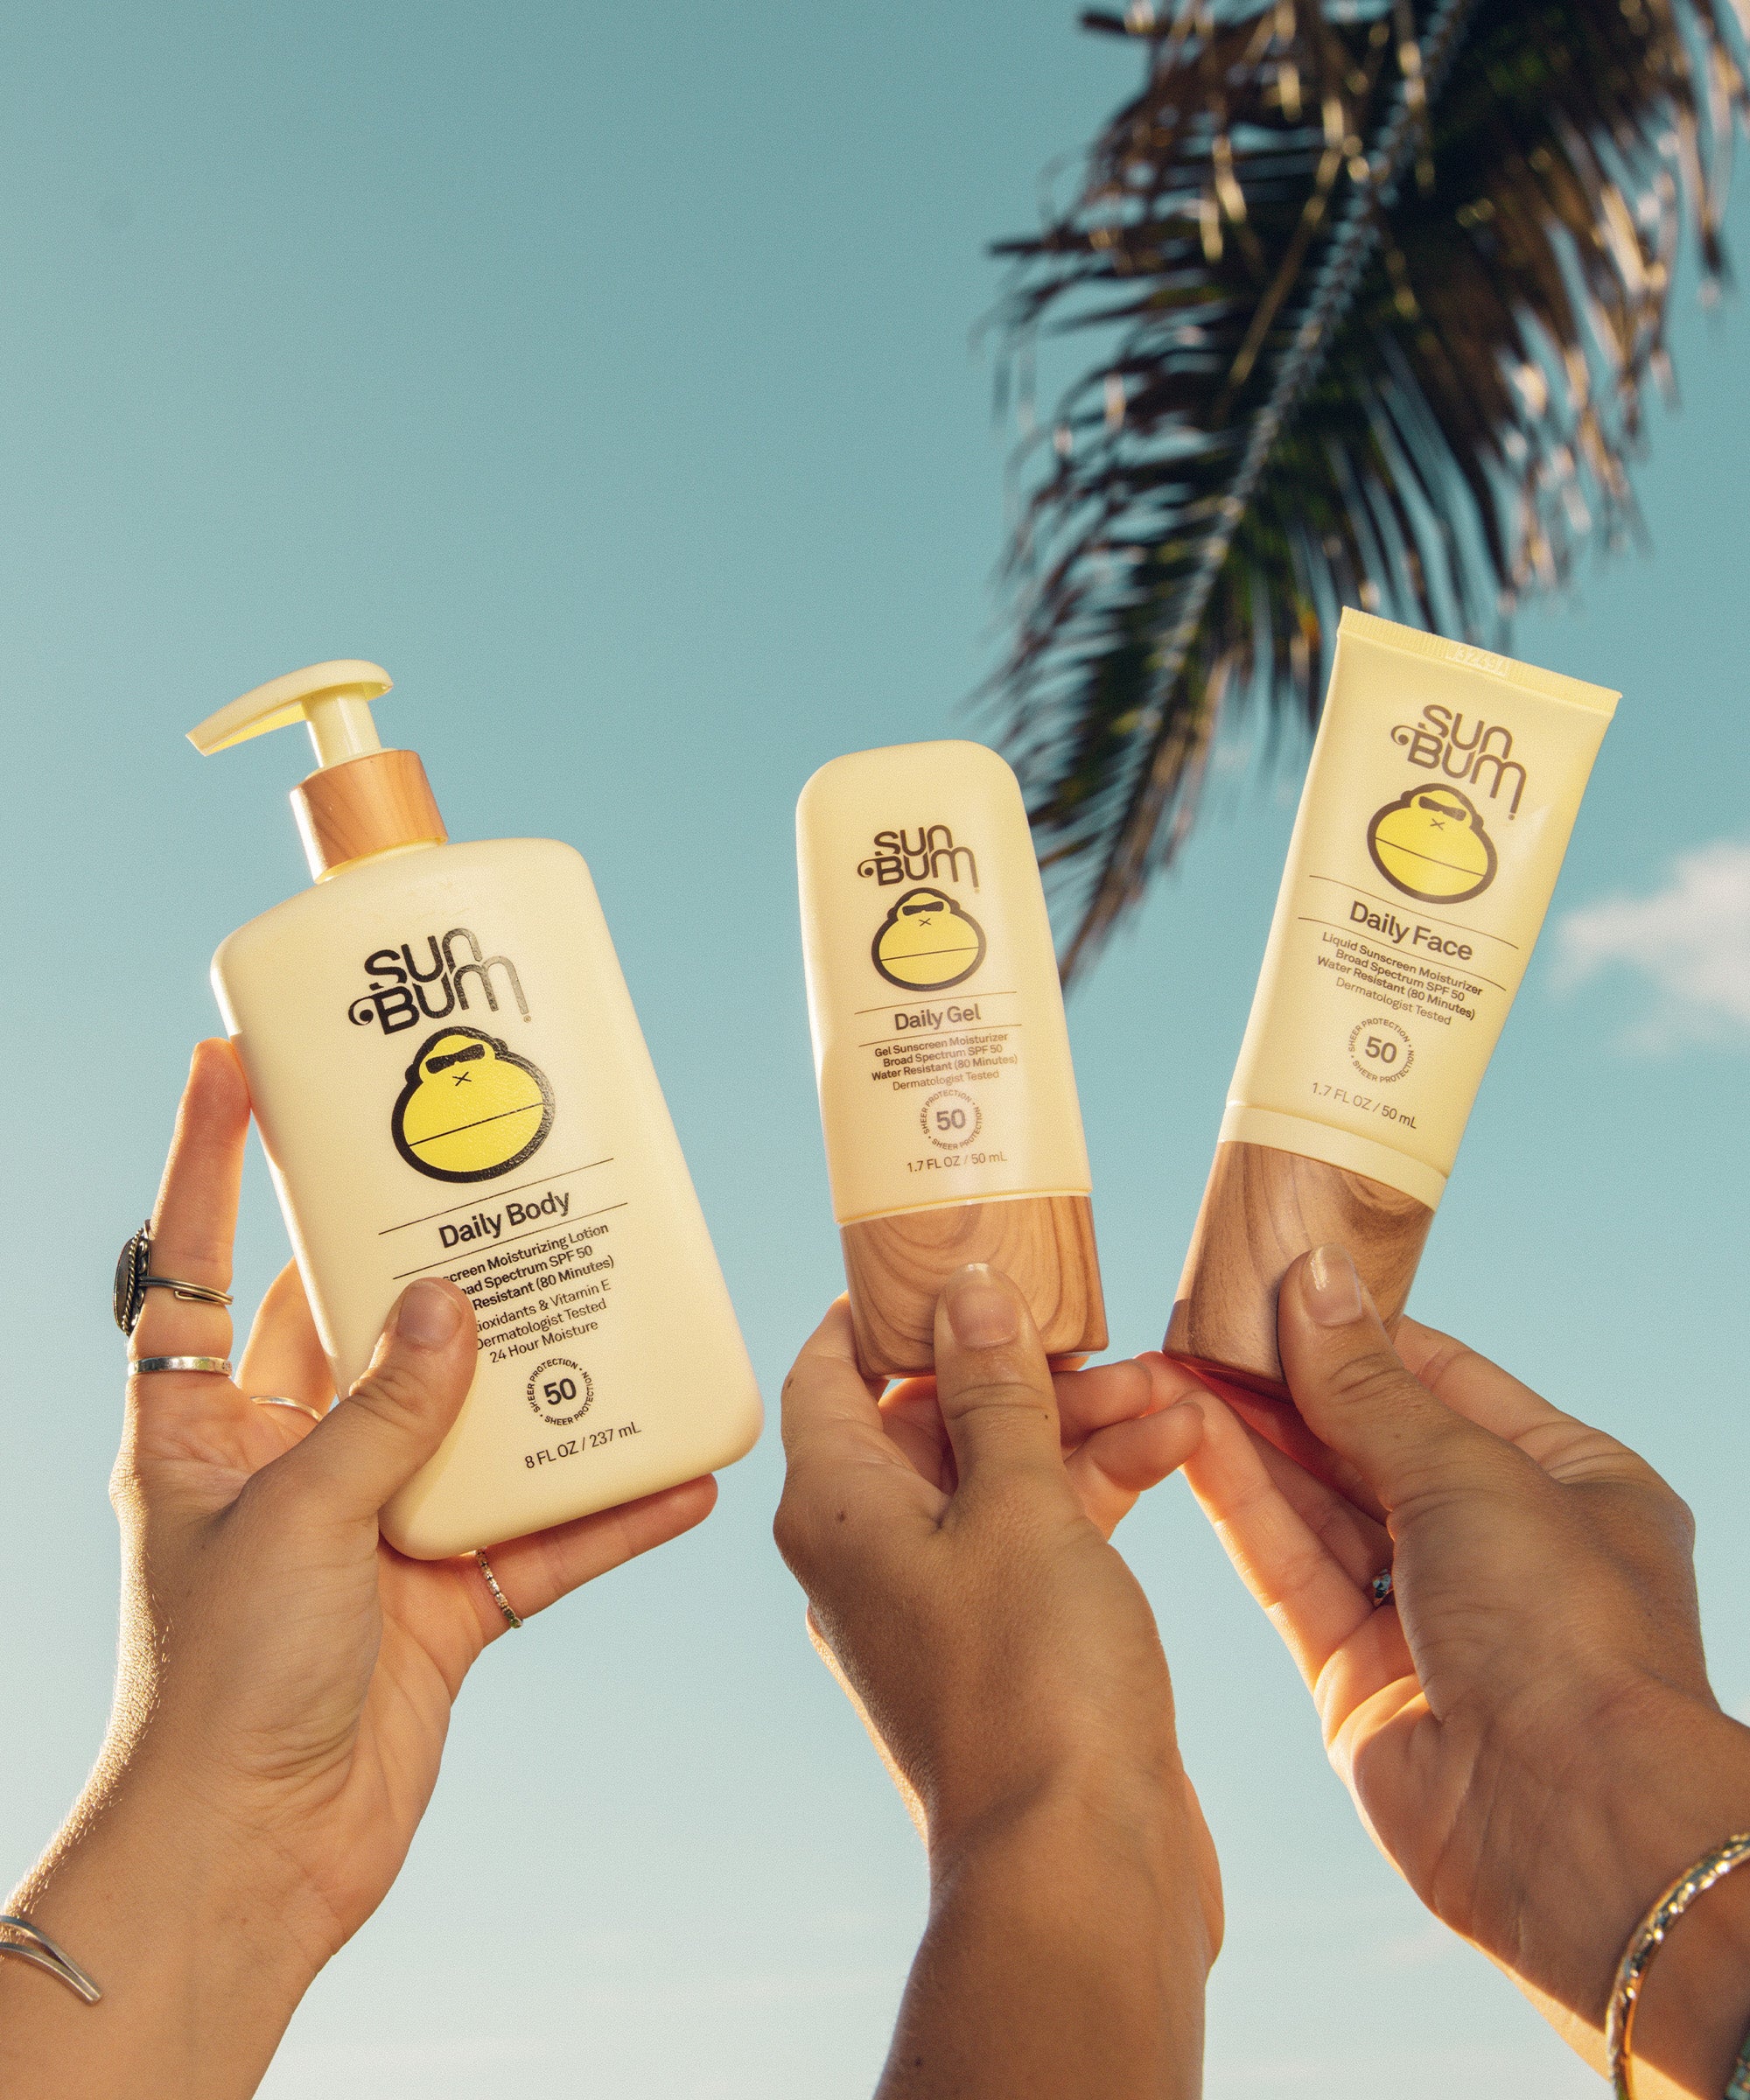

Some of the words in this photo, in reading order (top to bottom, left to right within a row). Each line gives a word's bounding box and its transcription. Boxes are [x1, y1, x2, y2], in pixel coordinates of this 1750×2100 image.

[1349, 900, 1410, 943] Daily
[1411, 925, 1473, 961] Face
[1322, 931, 1358, 951] Liquid
[1359, 944, 1417, 974] Sunscreen
[1418, 966, 1483, 996] Moisturizer
[1335, 948, 1369, 968] Broad
[1370, 962, 1424, 988] Spectrum
[1425, 981, 1450, 996] SPF
[1451, 990, 1465, 1002] 50
[1317, 956, 1352, 974] Water
[1353, 968, 1405, 995] Resistant
[1407, 987, 1425, 1001] (80
[1426, 994, 1476, 1021] Minutes)
[1335, 976, 1413, 1011] Dermatologist
[1416, 1004, 1452, 1026] Tested
[894, 1009, 943, 1030] Daily
[947, 1003, 982, 1023] Gel
[1348, 1025, 1362, 1053] SHEER
[1362, 1018, 1410, 1042] PROTECTION
[874, 1046, 892, 1057] Gel
[892, 1040, 948, 1054] Sunscreen
[949, 1033, 1008, 1047] Moisturizer
[883, 1054, 914, 1068] Broad
[915, 1049, 966, 1064] Spectrum
[968, 1045, 989, 1056] SPF
[990, 1044, 1003, 1054] 50
[1365, 1035, 1397, 1064] 50
[872, 1068, 901, 1081] Water
[903, 1061, 952, 1076] Resistant
[954, 1059, 970, 1071] (80
[972, 1054, 1018, 1067] Minutes)
[892, 1073, 963, 1091] Dermatologist
[966, 1069, 1000, 1082] Tested
[1353, 1060, 1378, 1082] SHEER
[1379, 1050, 1415, 1083] PROTECTION
[920, 1107, 930, 1135] SHEER
[925, 1089, 972, 1107] PROTECTION
[936, 1109, 966, 1131] 50
[1312, 1082, 1332, 1096] 1.7
[1334, 1088, 1350, 1103] FL
[1353, 1095, 1372, 1110] OZ
[1382, 1105, 1397, 1120] 50
[1398, 1114, 1417, 1129] mL
[931, 1138, 958, 1151] SHEER
[959, 1107, 983, 1148] PROTECTION
[906, 1160, 924, 1172] 1.7
[927, 1158, 942, 1170] FL
[943, 1155, 961, 1167] OZ
[971, 1152, 986, 1165] 50
[989, 1152, 1008, 1163] mL
[438, 1213, 501, 1248] Daily
[505, 1191, 570, 1227] Body
[486, 1236, 570, 1270] Moisturizing
[568, 1224, 609, 1244] Lotion
[472, 1282, 535, 1311] Resistant
[536, 1277, 557, 1292] (80
[559, 1255, 614, 1283] Minutes)
[484, 1261, 548, 1292] Spectrum
[549, 1250, 574, 1269] SPF
[577, 1245, 593, 1259] 50
[539, 1298, 550, 1312] &
[550, 1283, 600, 1307] Vitamin
[600, 1278, 612, 1291] E
[565, 1298, 607, 1321] Tested
[489, 1349, 508, 1363] 24
[508, 1339, 539, 1357] Hour
[542, 1320, 598, 1348] Moisture
[529, 1358, 578, 1382] PROTECTION
[527, 1382, 541, 1413] SHEER
[543, 1377, 577, 1406] 50
[544, 1415, 574, 1426] SHEER
[573, 1371, 594, 1422] PROTECTION
[525, 1455, 536, 1469] 8
[536, 1449, 556, 1465] FL
[557, 1440, 579, 1458] OZ
[589, 1428, 613, 1448] 237
[618, 1421, 641, 1438] mL
